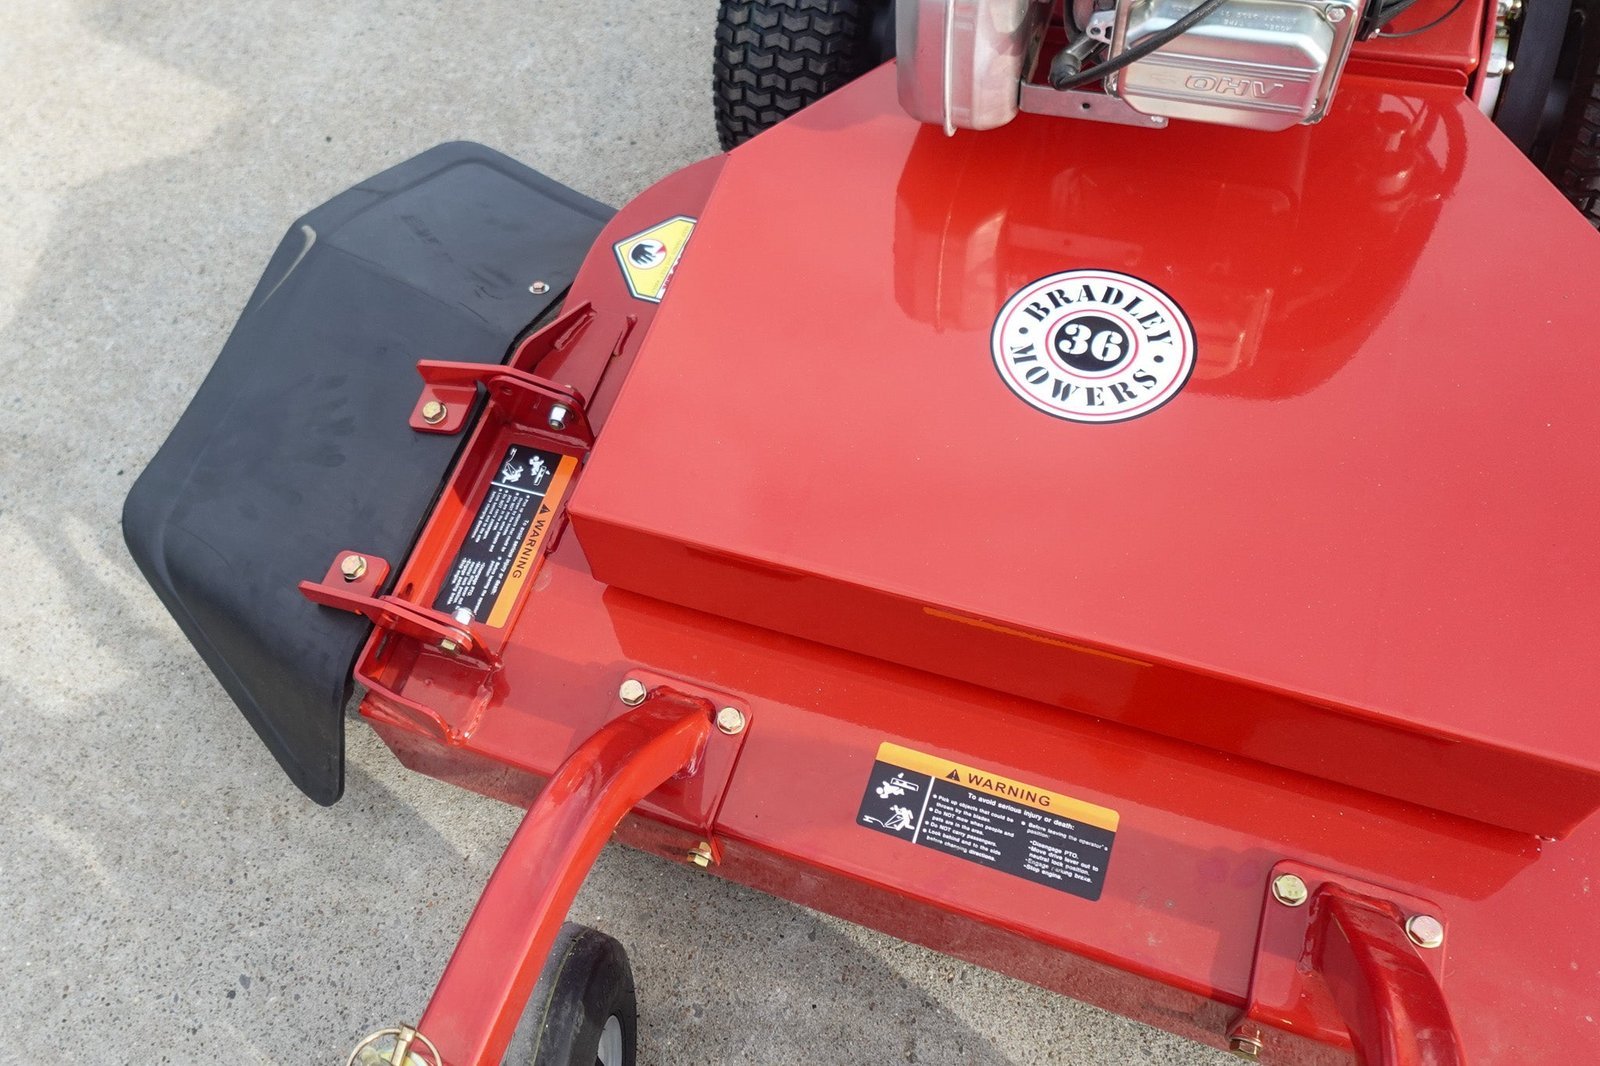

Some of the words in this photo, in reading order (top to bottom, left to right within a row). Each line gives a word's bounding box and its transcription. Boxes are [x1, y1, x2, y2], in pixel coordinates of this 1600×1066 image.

[1185, 75, 1283, 98] OHV
[1023, 285, 1173, 346] BRADLEY
[1059, 324, 1123, 362] 36
[1010, 343, 1158, 406] MOWERS
[513, 519, 546, 578] WARNING
[968, 792, 977, 800] To
[978, 797, 996, 806] avoid
[997, 803, 1022, 814] serious
[1023, 810, 1042, 821] injury
[969, 774, 1050, 806] WARNING
[939, 824, 951, 832] NOT
